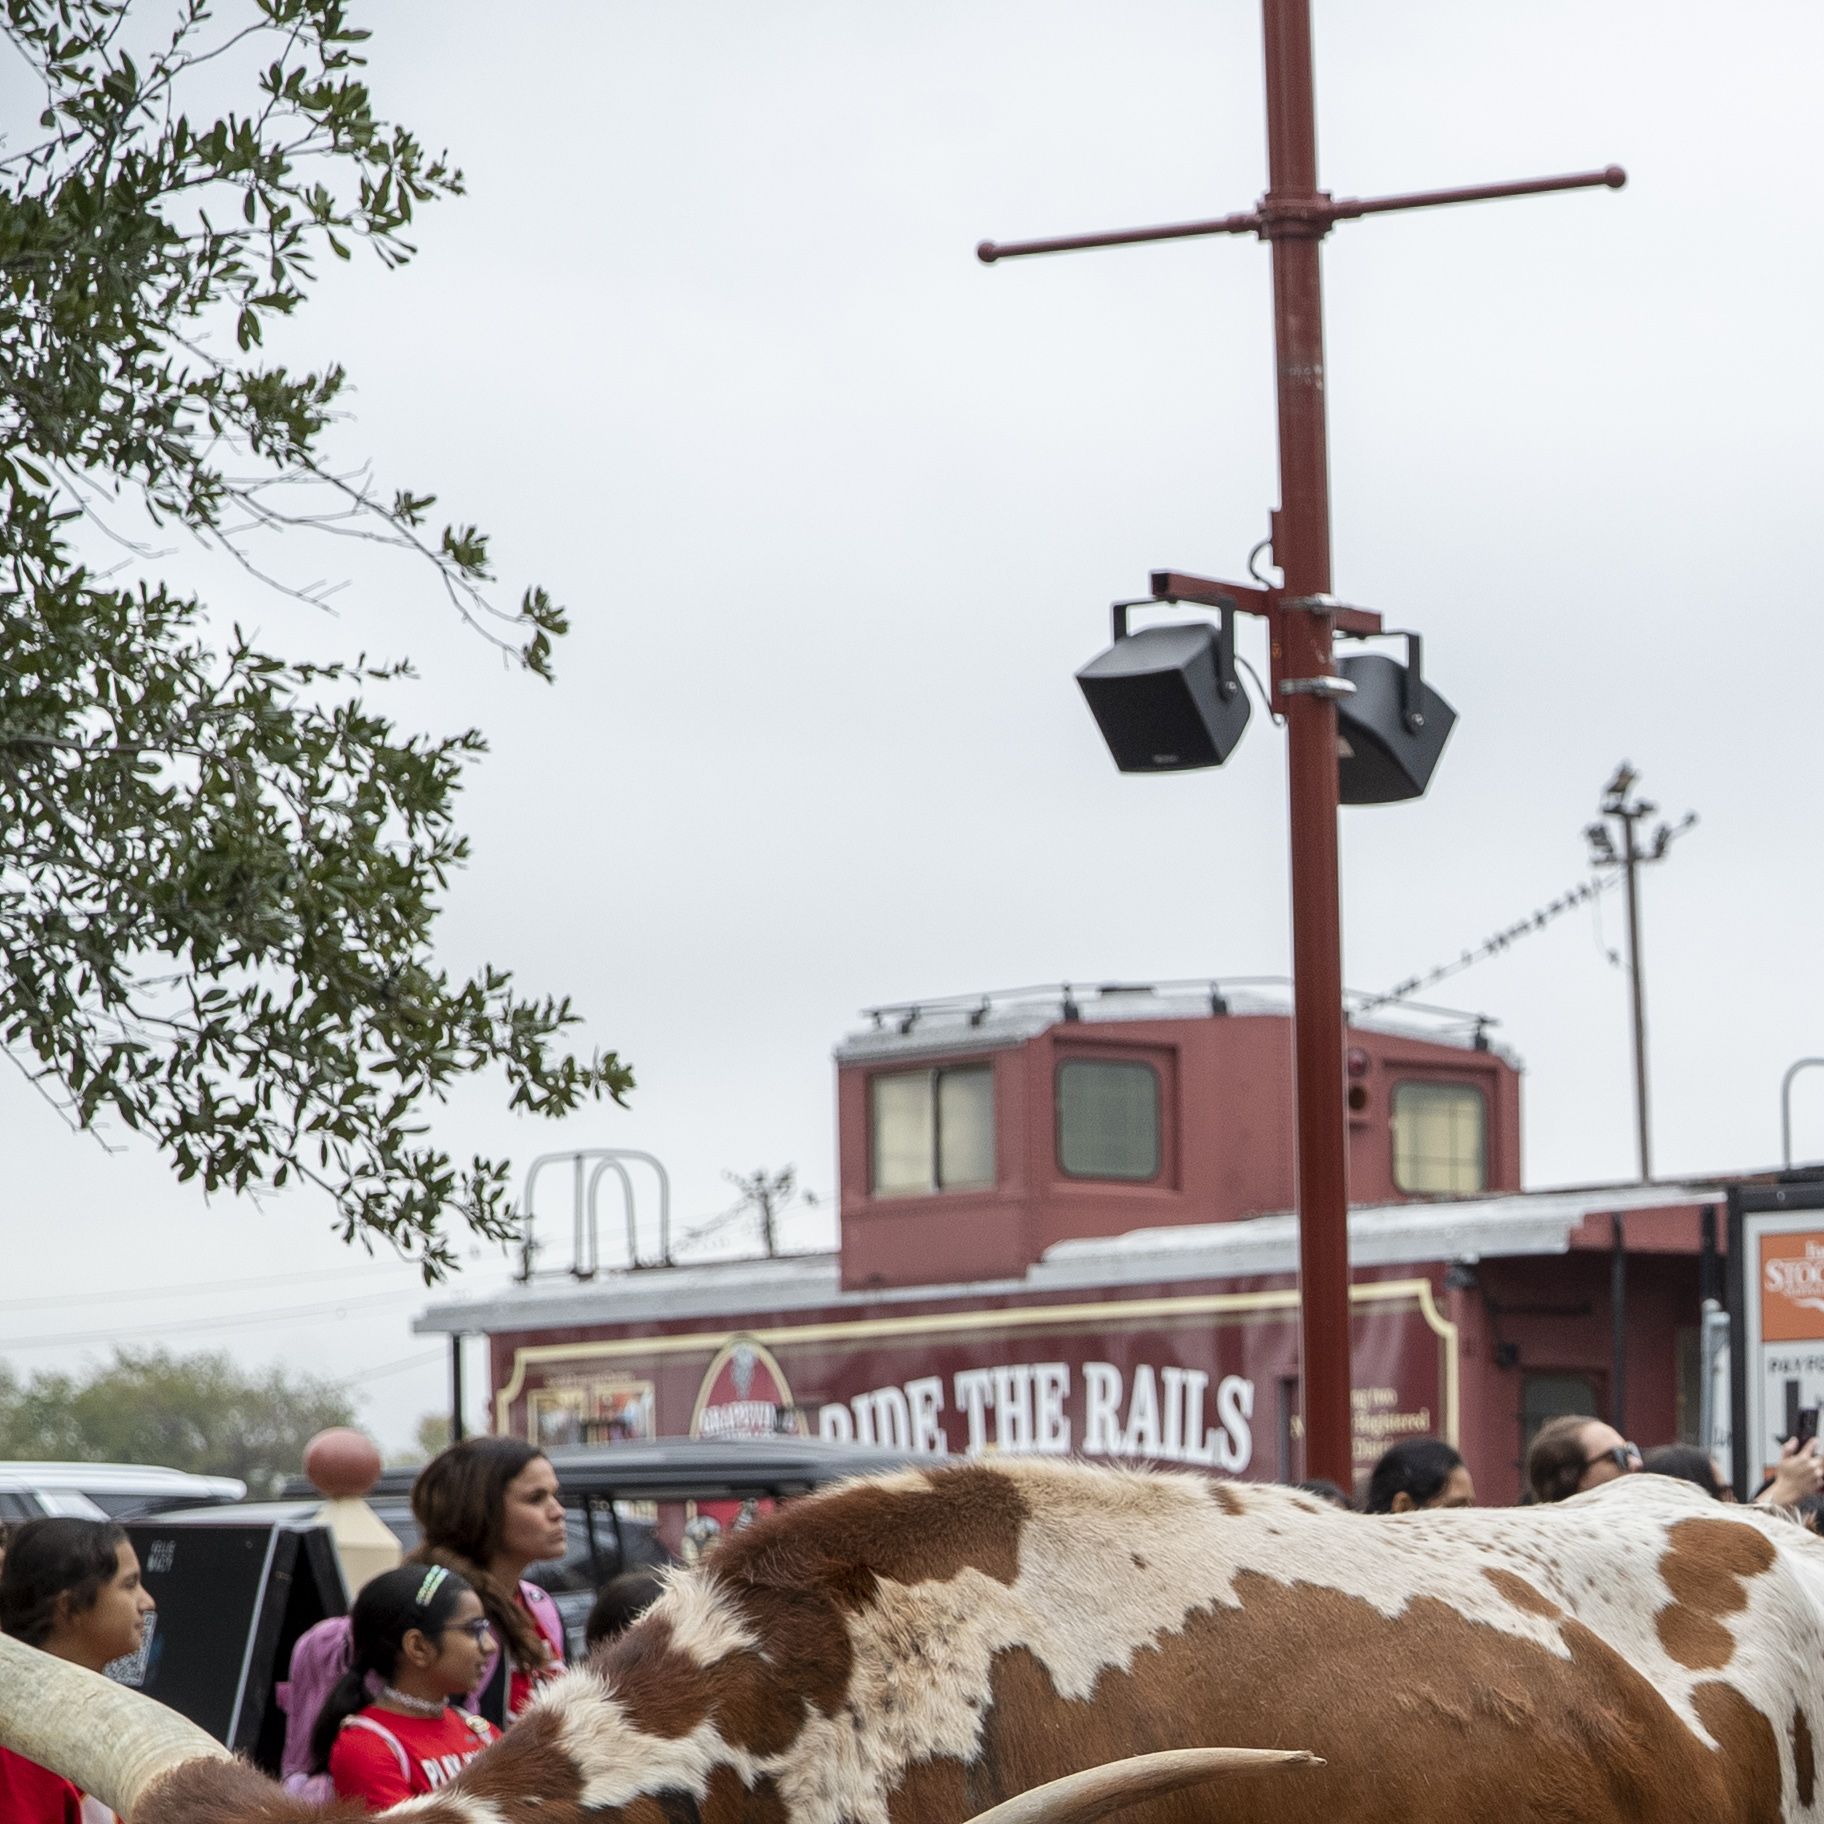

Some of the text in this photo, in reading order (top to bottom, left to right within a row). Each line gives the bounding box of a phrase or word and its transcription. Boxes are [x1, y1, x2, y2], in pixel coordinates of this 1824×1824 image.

[1768, 1354, 1800, 1373] PAY
[818, 1361, 1255, 1474] RIDE THE RAILS
